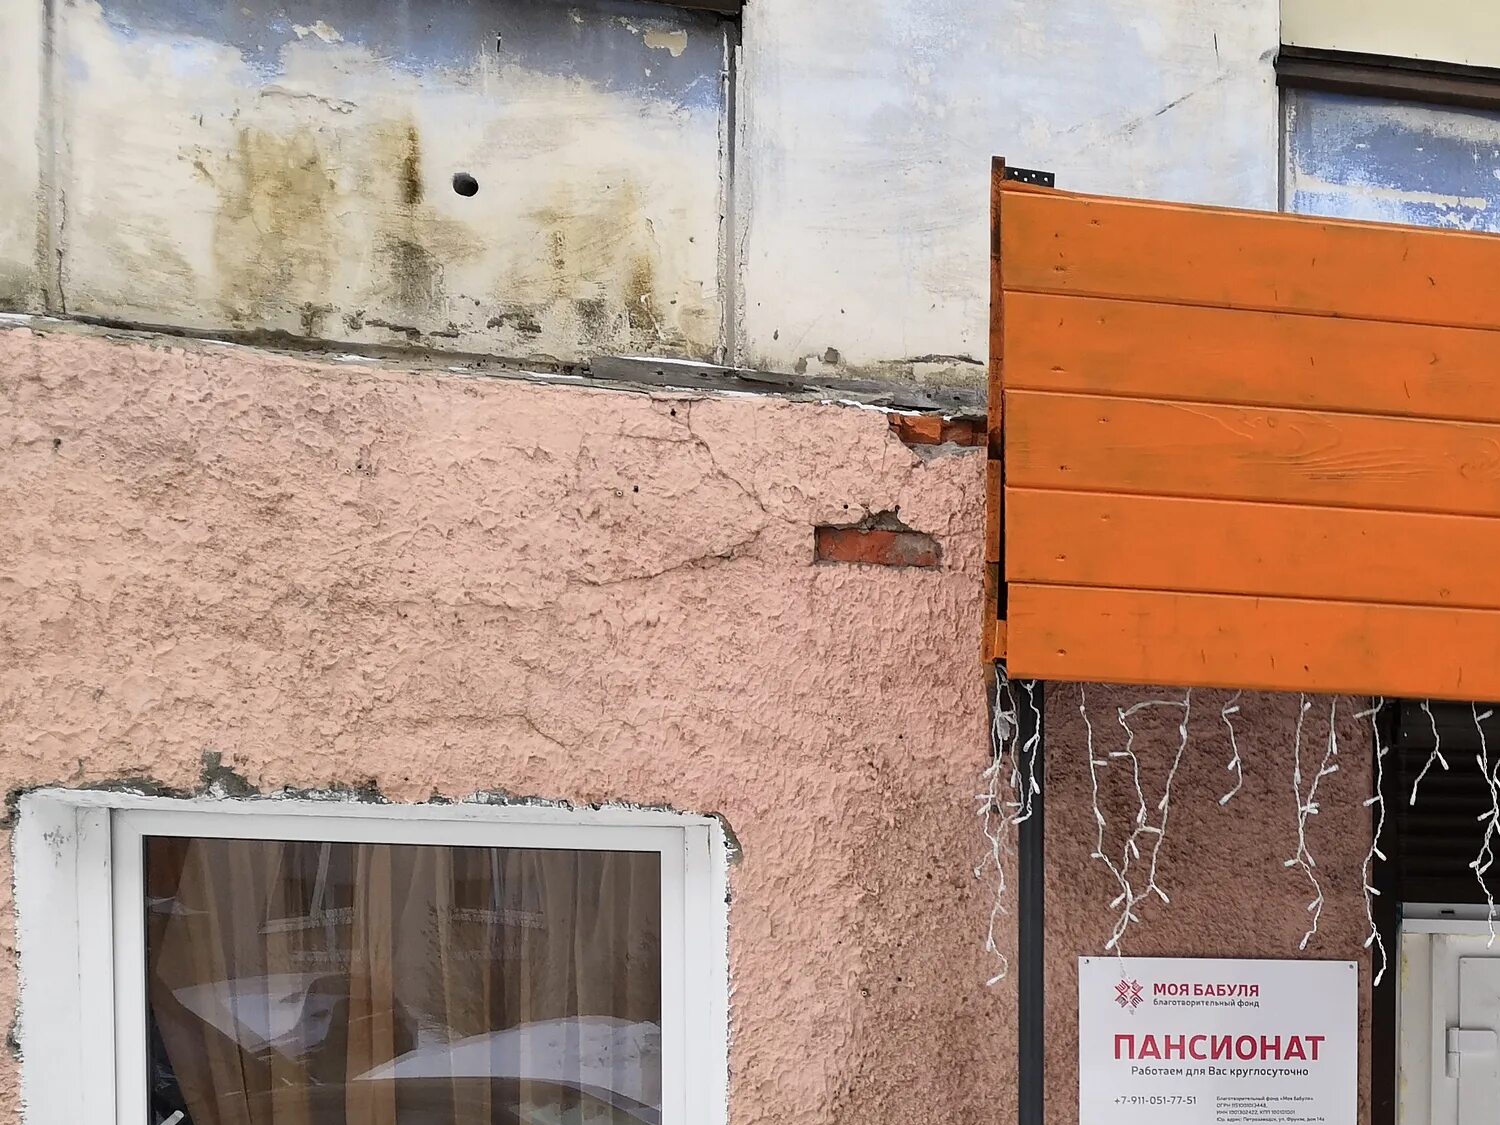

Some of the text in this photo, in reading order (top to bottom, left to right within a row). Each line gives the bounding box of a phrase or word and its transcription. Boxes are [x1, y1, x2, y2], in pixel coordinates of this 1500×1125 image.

[1153, 983, 1260, 997] МОЯ БАБУЛЯ
[1153, 998, 1260, 1009] благотворительный фонд
[1114, 1034, 1326, 1061] ПАНСИОНАТ
[1131, 1066, 1309, 1079] Работаем для Вас круглосуточно
[1114, 1095, 1197, 1105] +7-911-051-77-51
